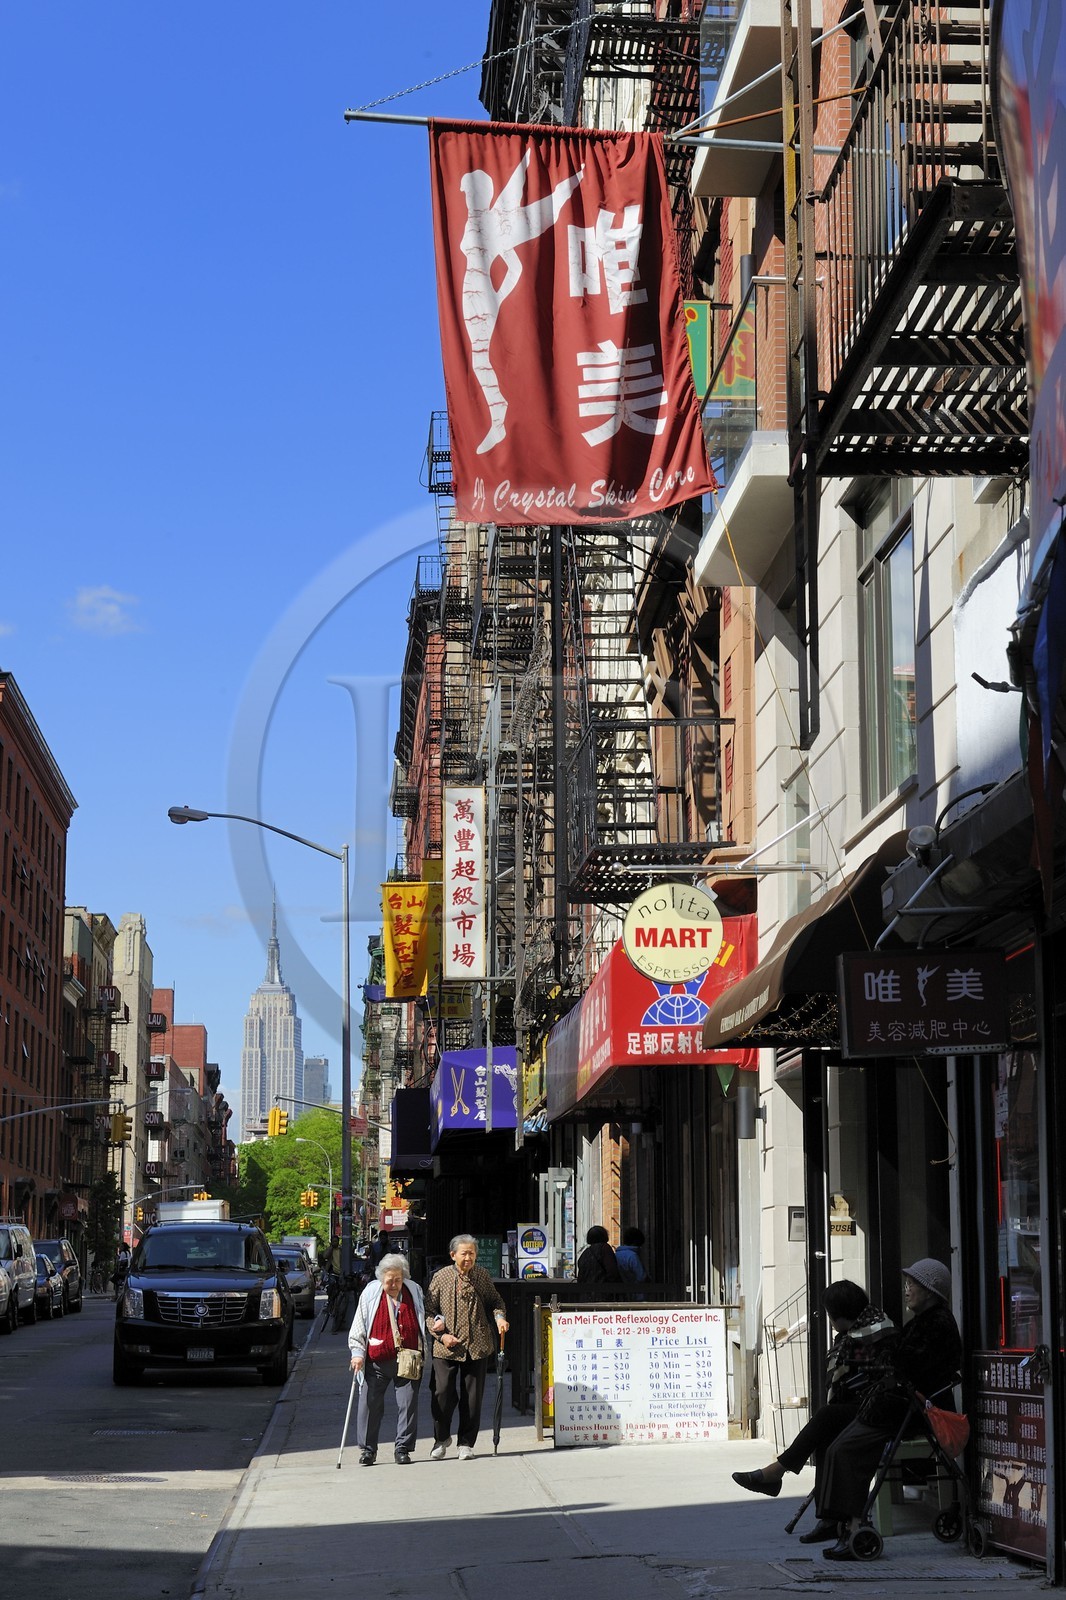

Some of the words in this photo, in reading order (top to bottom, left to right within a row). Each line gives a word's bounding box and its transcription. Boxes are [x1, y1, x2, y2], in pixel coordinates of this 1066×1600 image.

[567, 204, 668, 447] 唯美
[493, 479, 575, 515] Crystal
[589, 479, 637, 508] Skin
[649, 465, 695, 503] Care
[451, 798, 480, 968] 萬豐超級市場
[387, 894, 423, 911] 台山
[638, 886, 709, 920] nolita
[635, 928, 712, 948] MART
[637, 954, 710, 979] ESPRESSO
[148, 1014, 162, 1026] LAU
[867, 1018, 991, 1042] 美容減肥中心
[145, 1113, 159, 1125] SON
[145, 1164, 157, 1175] CO.
[574, 1315, 591, 1324] Mei
[593, 1315, 613, 1324] Foot
[615, 1314, 669, 1325] Reflexology
[672, 1313, 703, 1323] Center
[705, 1313, 721, 1322] Inc.
[651, 1336, 679, 1346] Price
[687, 1336, 708, 1345] List
[614, 1352, 629, 1360] $12
[649, 1351, 659, 1359] 15
[695, 1350, 711, 1358] $12
[614, 1362, 629, 1370] $20
[663, 1361, 680, 1369] Min
[696, 1360, 712, 1368] $20
[615, 1383, 630, 1391] $45
[696, 1381, 712, 1389] $45
[560, 1424, 593, 1432] Business
[594, 1423, 620, 1431] Hours:
[707, 1420, 725, 1428] Days
